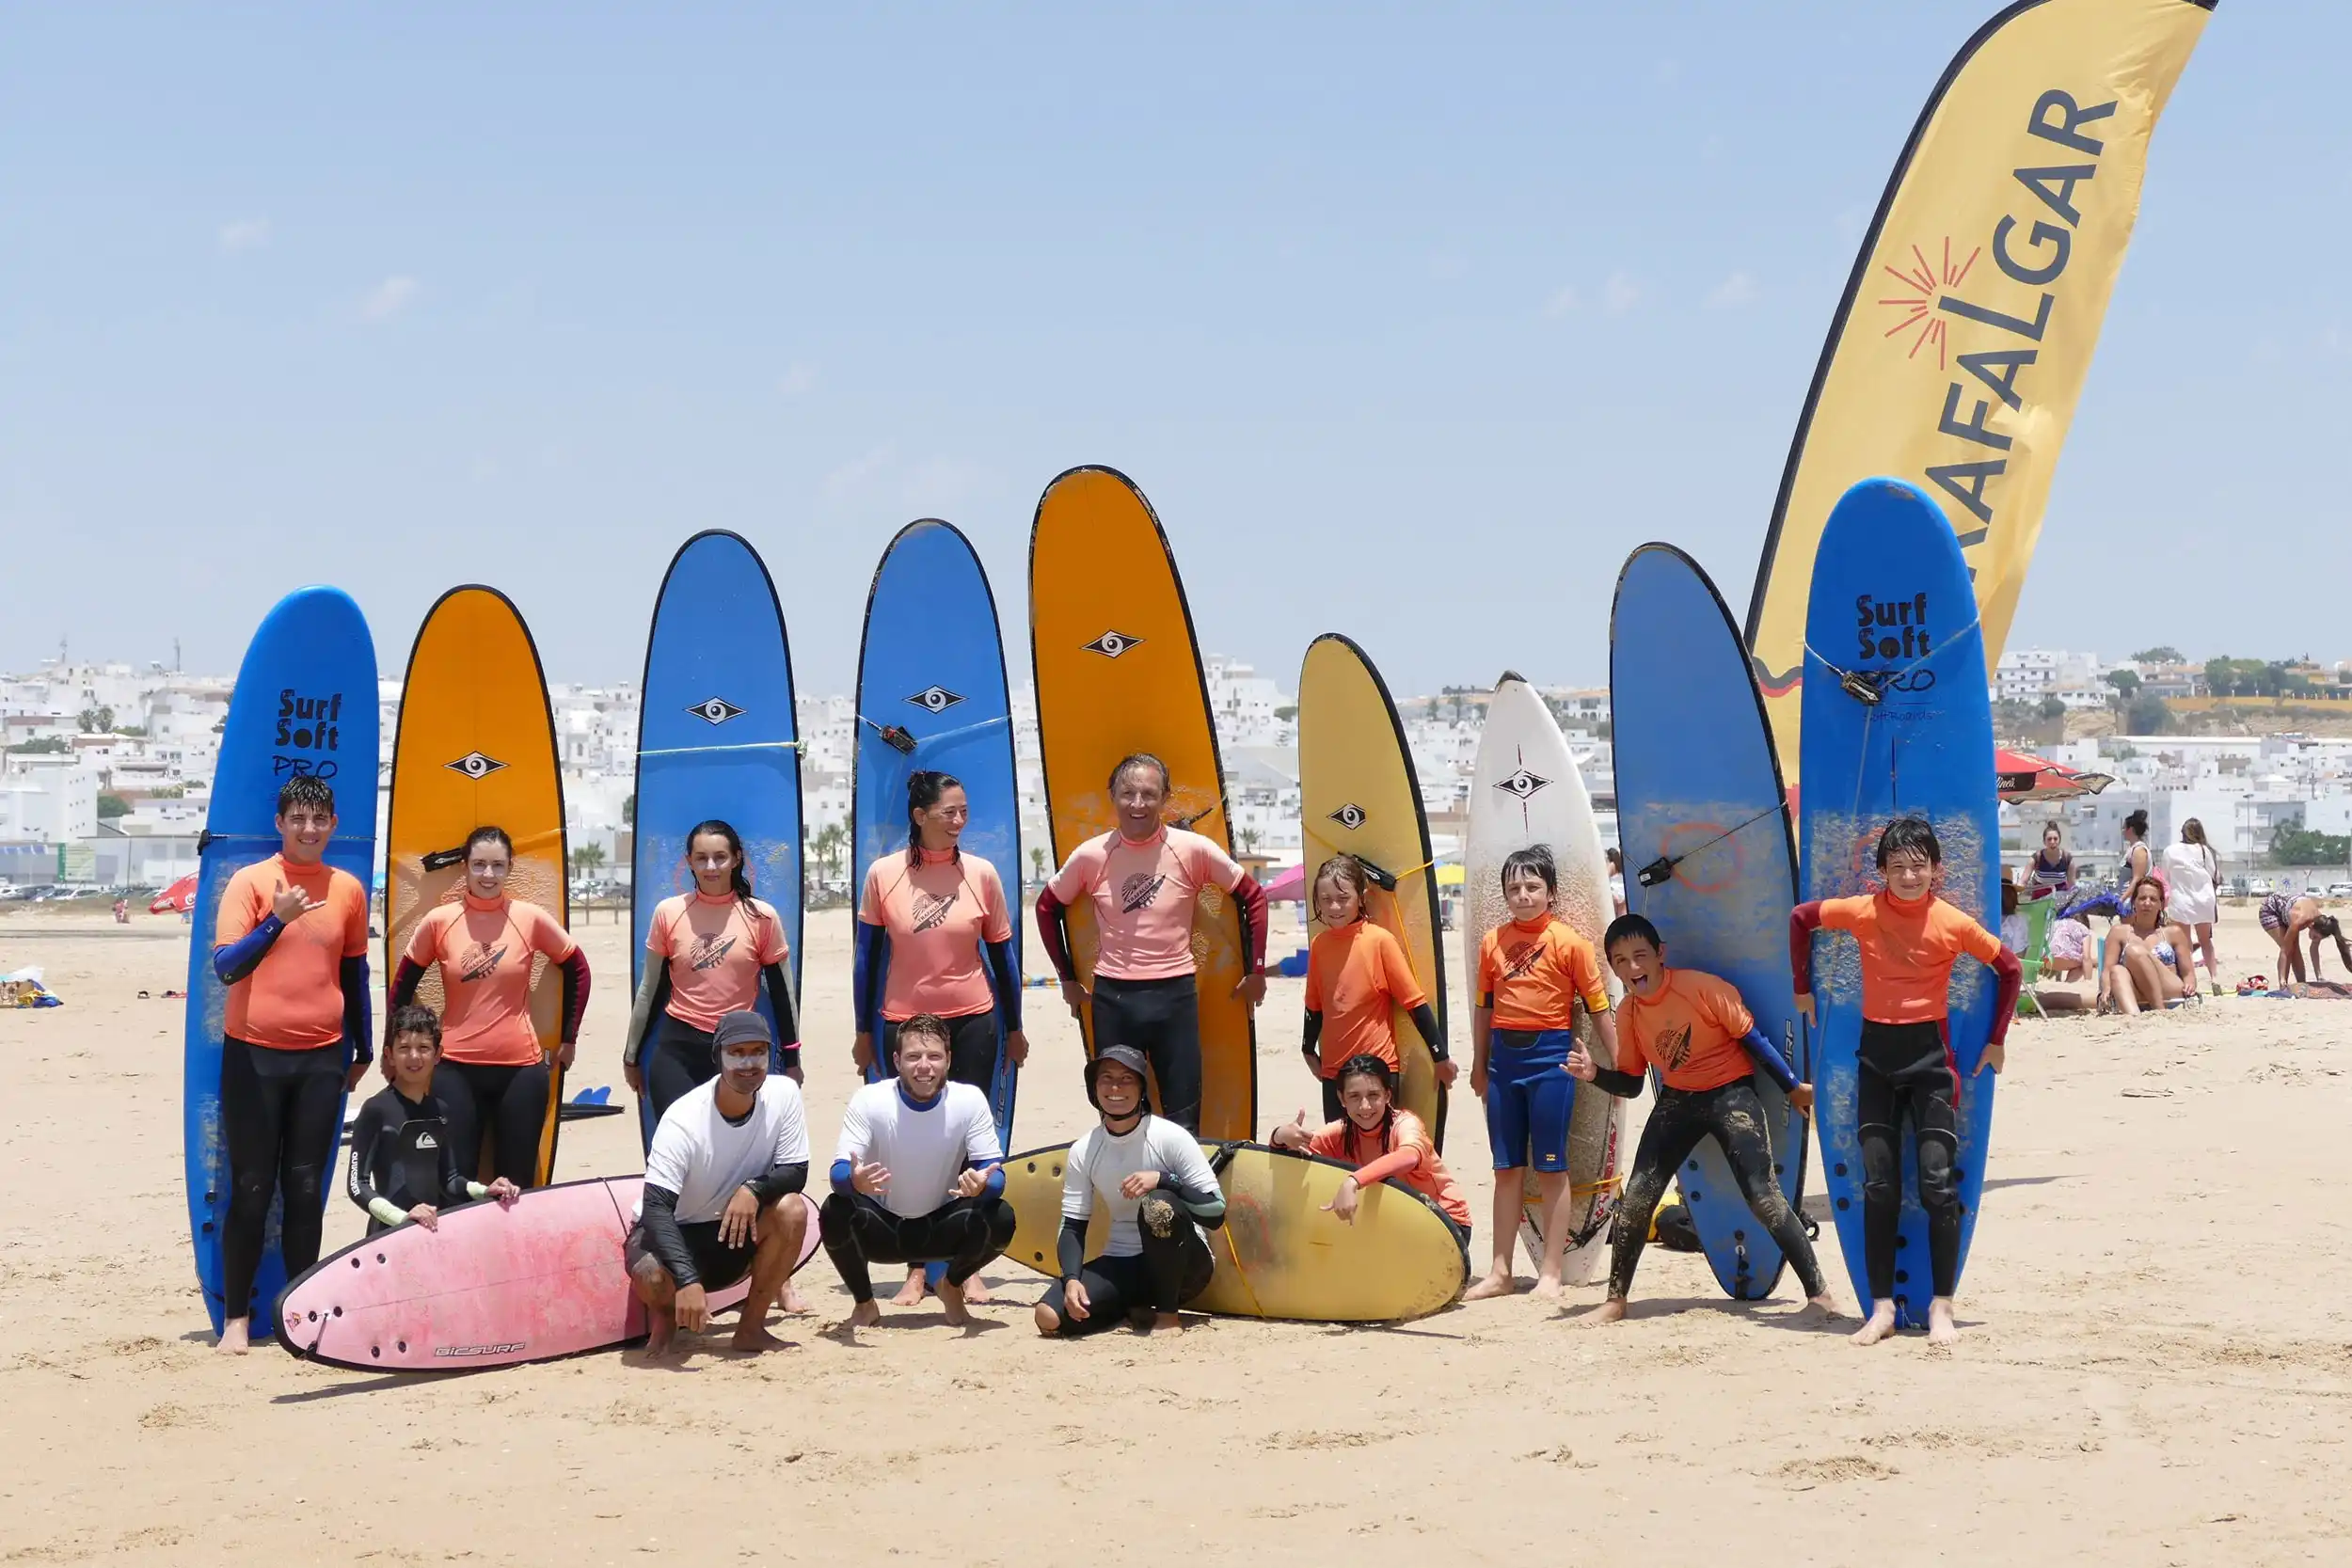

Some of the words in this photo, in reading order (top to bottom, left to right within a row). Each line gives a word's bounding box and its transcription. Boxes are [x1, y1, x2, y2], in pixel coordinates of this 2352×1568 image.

[1925, 88, 2119, 583] AFALGAR
[1856, 592, 1927, 627] Surf
[1858, 626, 1931, 659] Soft
[1858, 668, 1936, 693] RO
[278, 689, 342, 721] Surf
[275, 718, 340, 752] Soft
[272, 753, 339, 781] PRO
